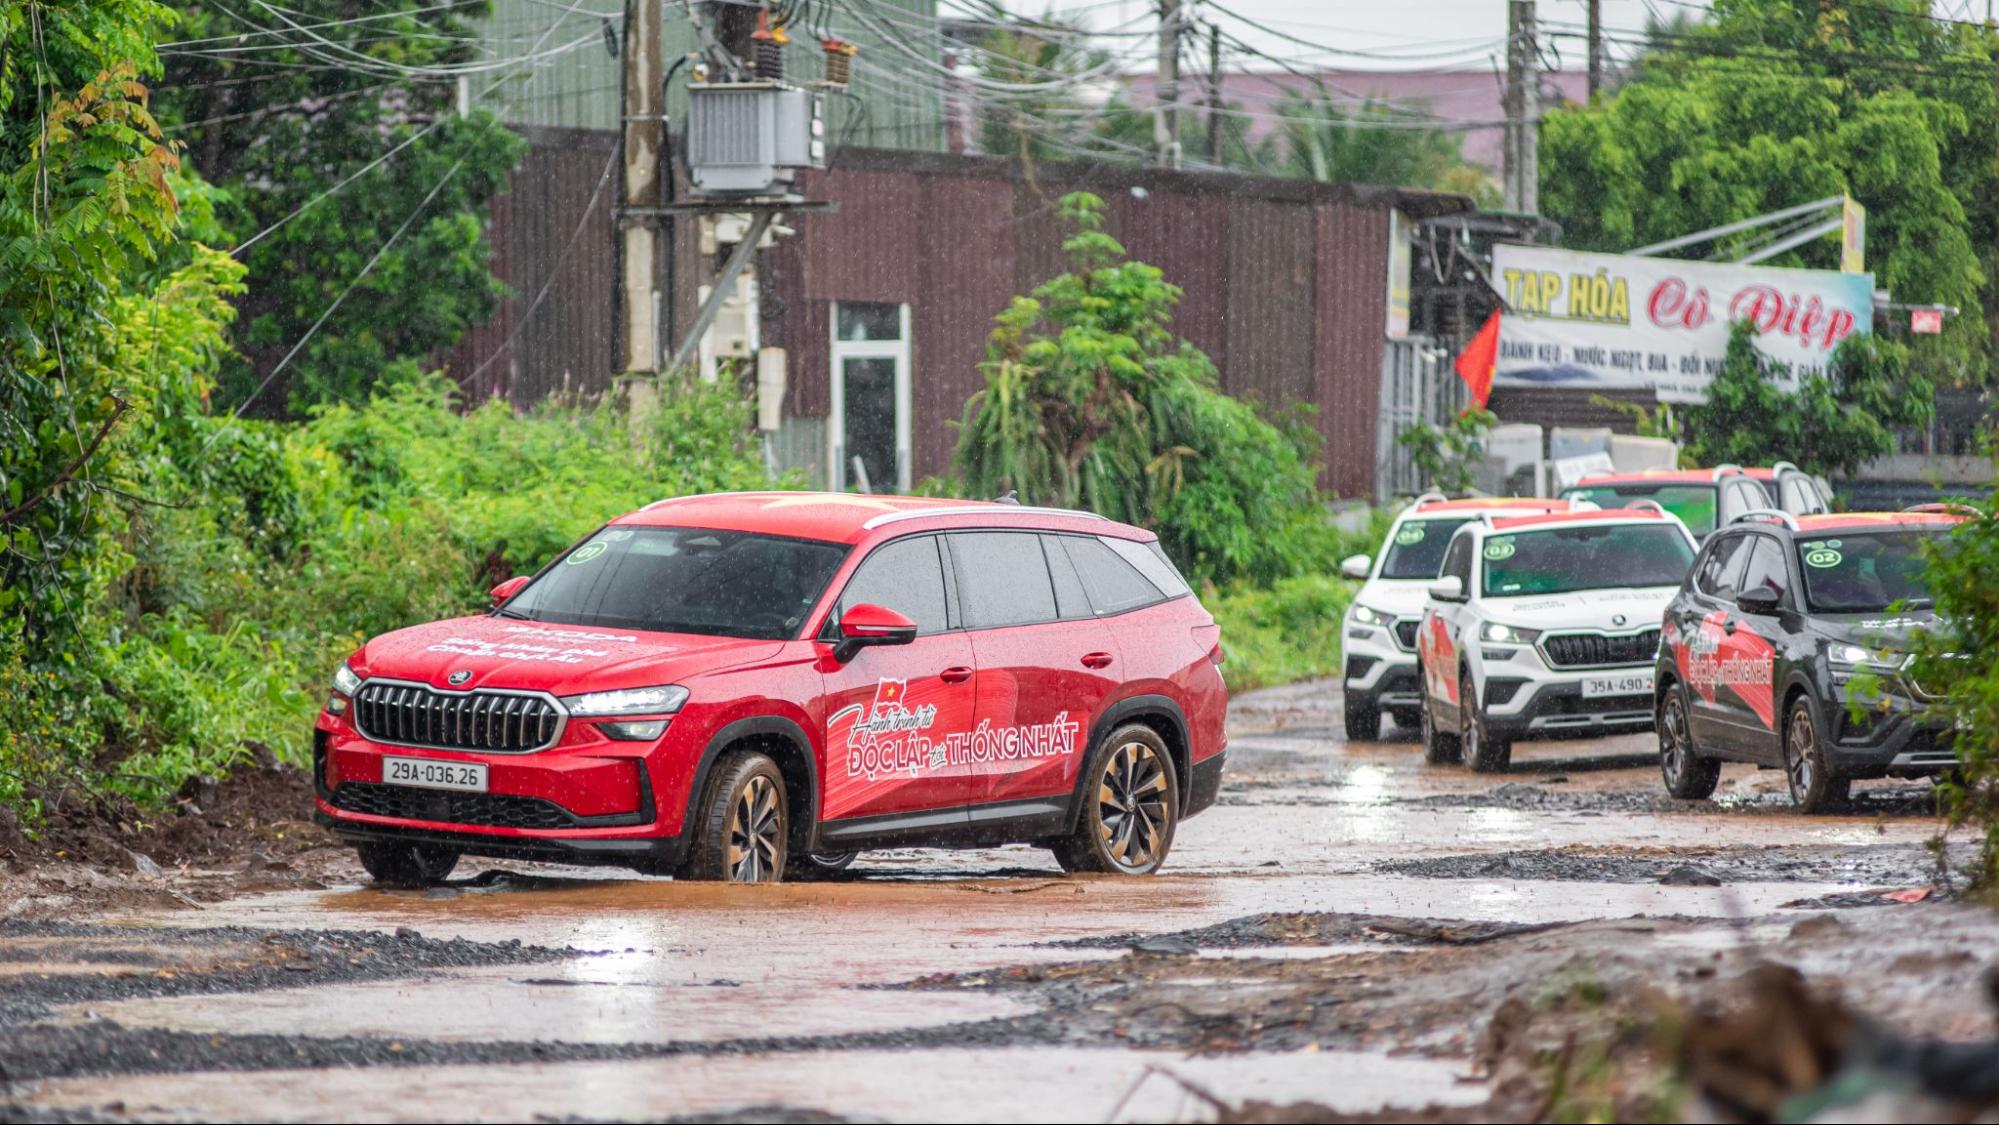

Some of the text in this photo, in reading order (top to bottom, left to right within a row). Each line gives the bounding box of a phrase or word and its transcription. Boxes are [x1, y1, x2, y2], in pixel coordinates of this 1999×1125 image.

[1567, 266, 1629, 325] HÓA
[1648, 277, 1711, 329] Cô
[1728, 285, 1855, 350] Điệp
[1812, 552, 1836, 564] 02
[1590, 678, 1655, 693] 35A-490.2
[828, 703, 937, 745] Hành trình từ
[847, 735, 895, 781] ĐỘC
[895, 731, 931, 778] LẬP
[946, 718, 1020, 765] THỐNG
[1020, 711, 1079, 757] NHẤT
[391, 762, 478, 786] 29A-036.26
